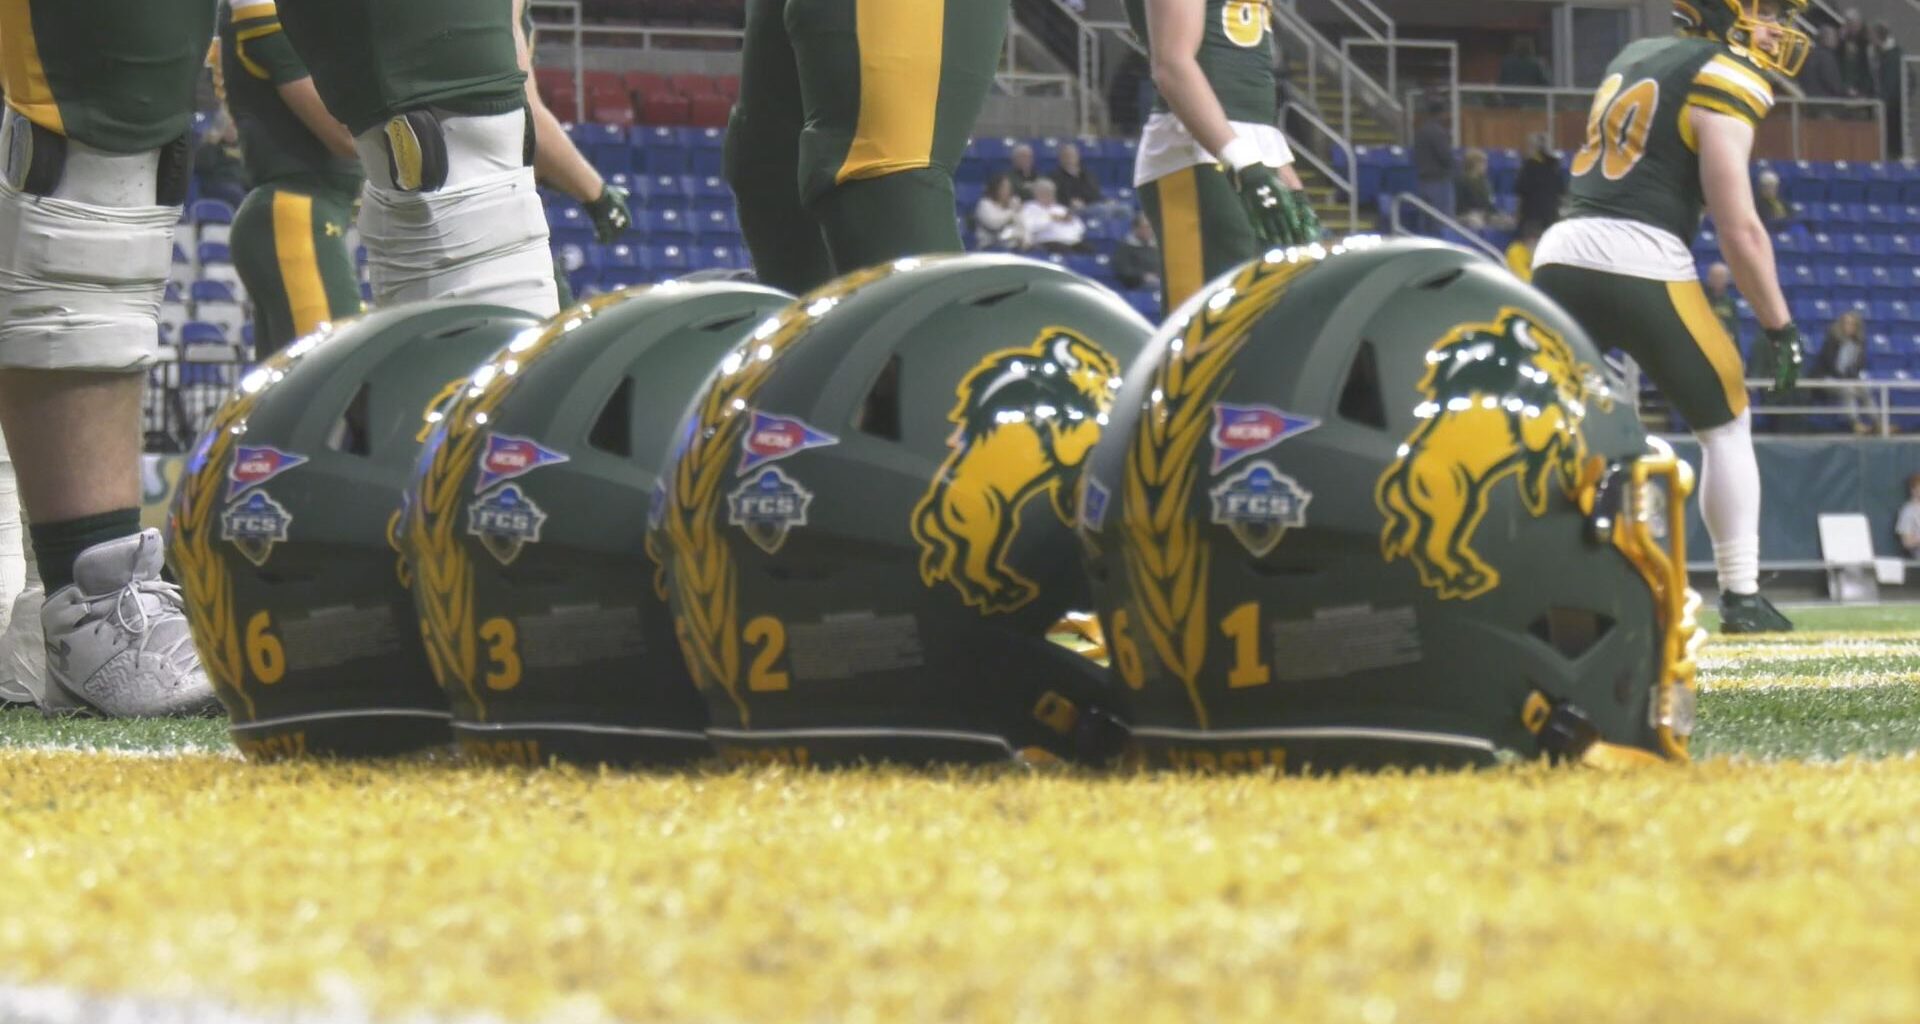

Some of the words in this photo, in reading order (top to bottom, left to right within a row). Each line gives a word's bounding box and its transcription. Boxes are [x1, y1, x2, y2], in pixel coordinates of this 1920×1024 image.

[232, 515, 277, 532] FCS
[481, 511, 529, 530] FCS
[742, 496, 794, 515] FCS
[1227, 494, 1291, 516] FCS
[246, 610, 286, 685] 6
[479, 617, 522, 691] 3
[743, 615, 789, 692] 2
[1221, 602, 1270, 689] 1
